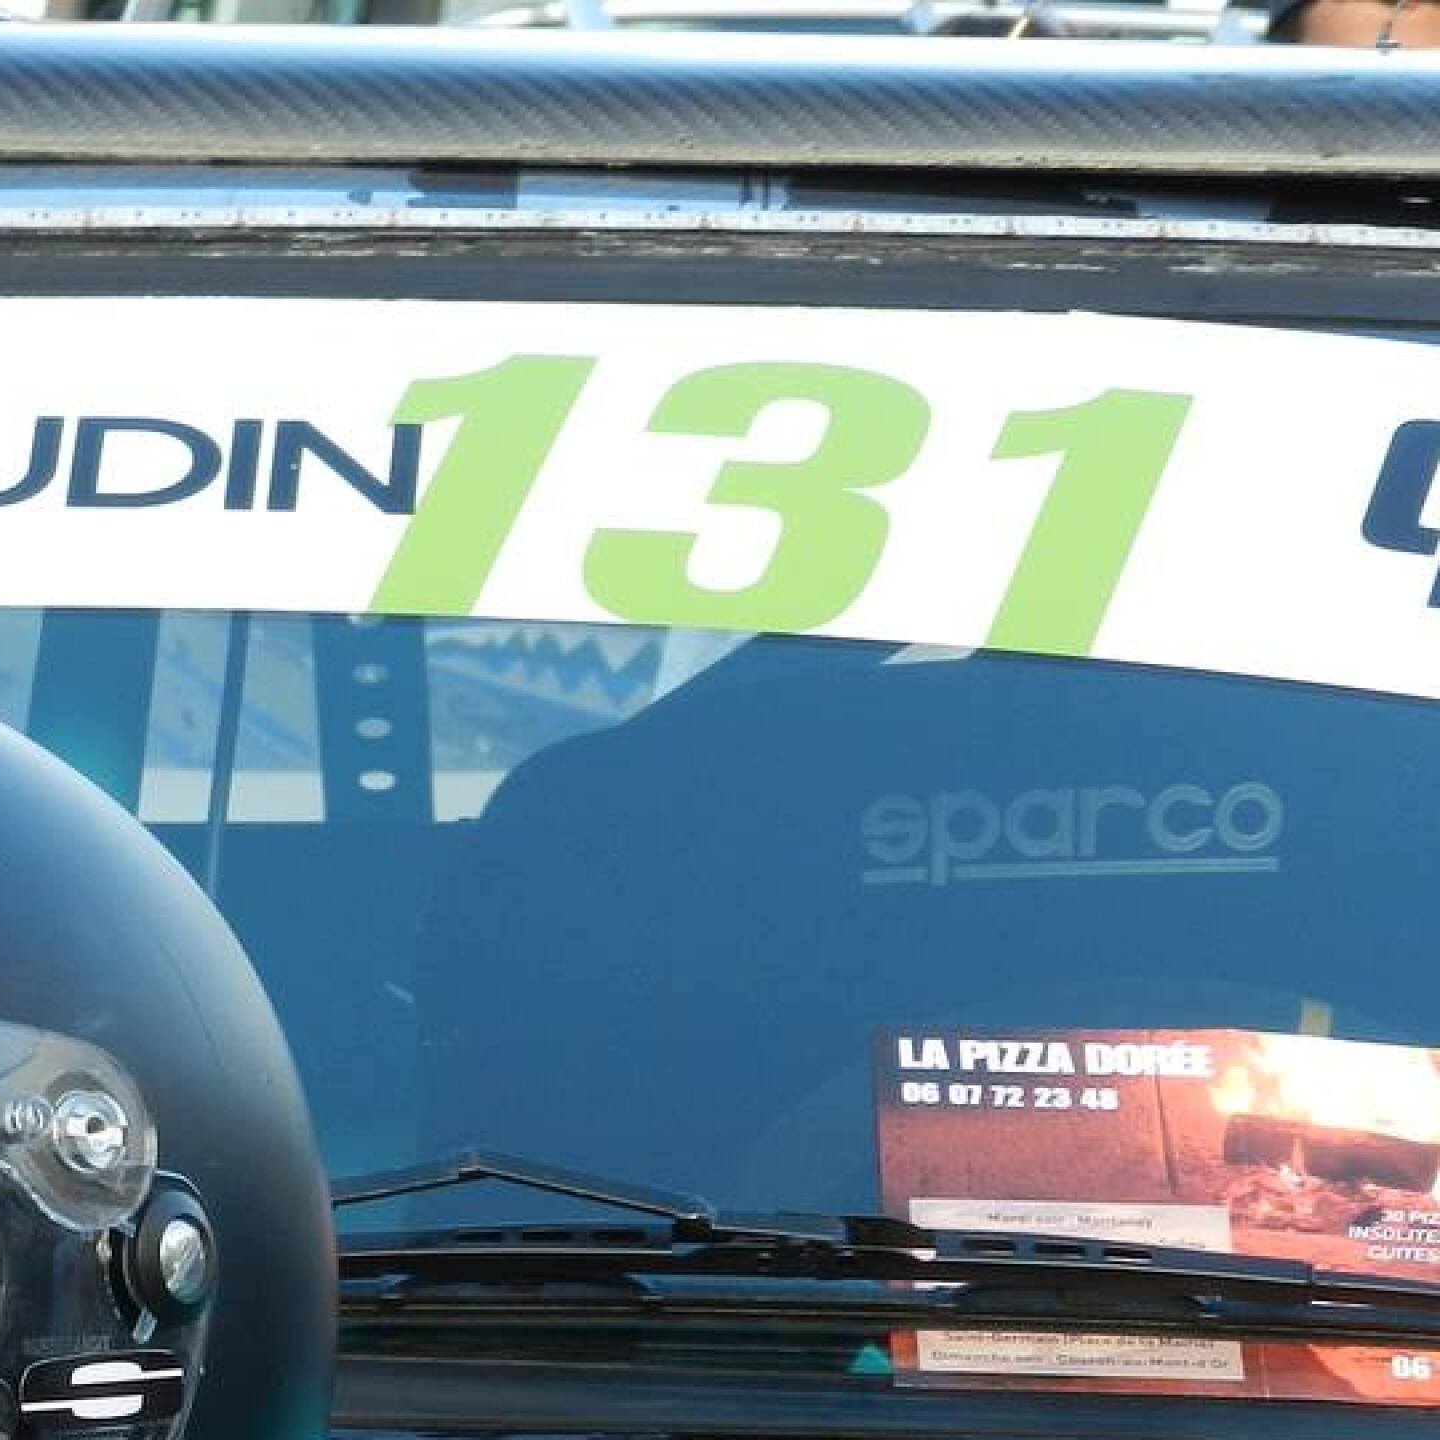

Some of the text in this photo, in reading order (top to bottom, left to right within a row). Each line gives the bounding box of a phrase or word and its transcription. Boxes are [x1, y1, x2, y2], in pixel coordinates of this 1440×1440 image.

[366, 352, 1194, 657] 131
[863, 781, 1283, 886] sparco
[897, 1037, 950, 1070] LA
[958, 1039, 1075, 1075] PIZZA
[900, 1082, 940, 1105] 06
[947, 1084, 982, 1106] 07
[990, 1085, 1025, 1108] 72
[1033, 1087, 1072, 1109] 23
